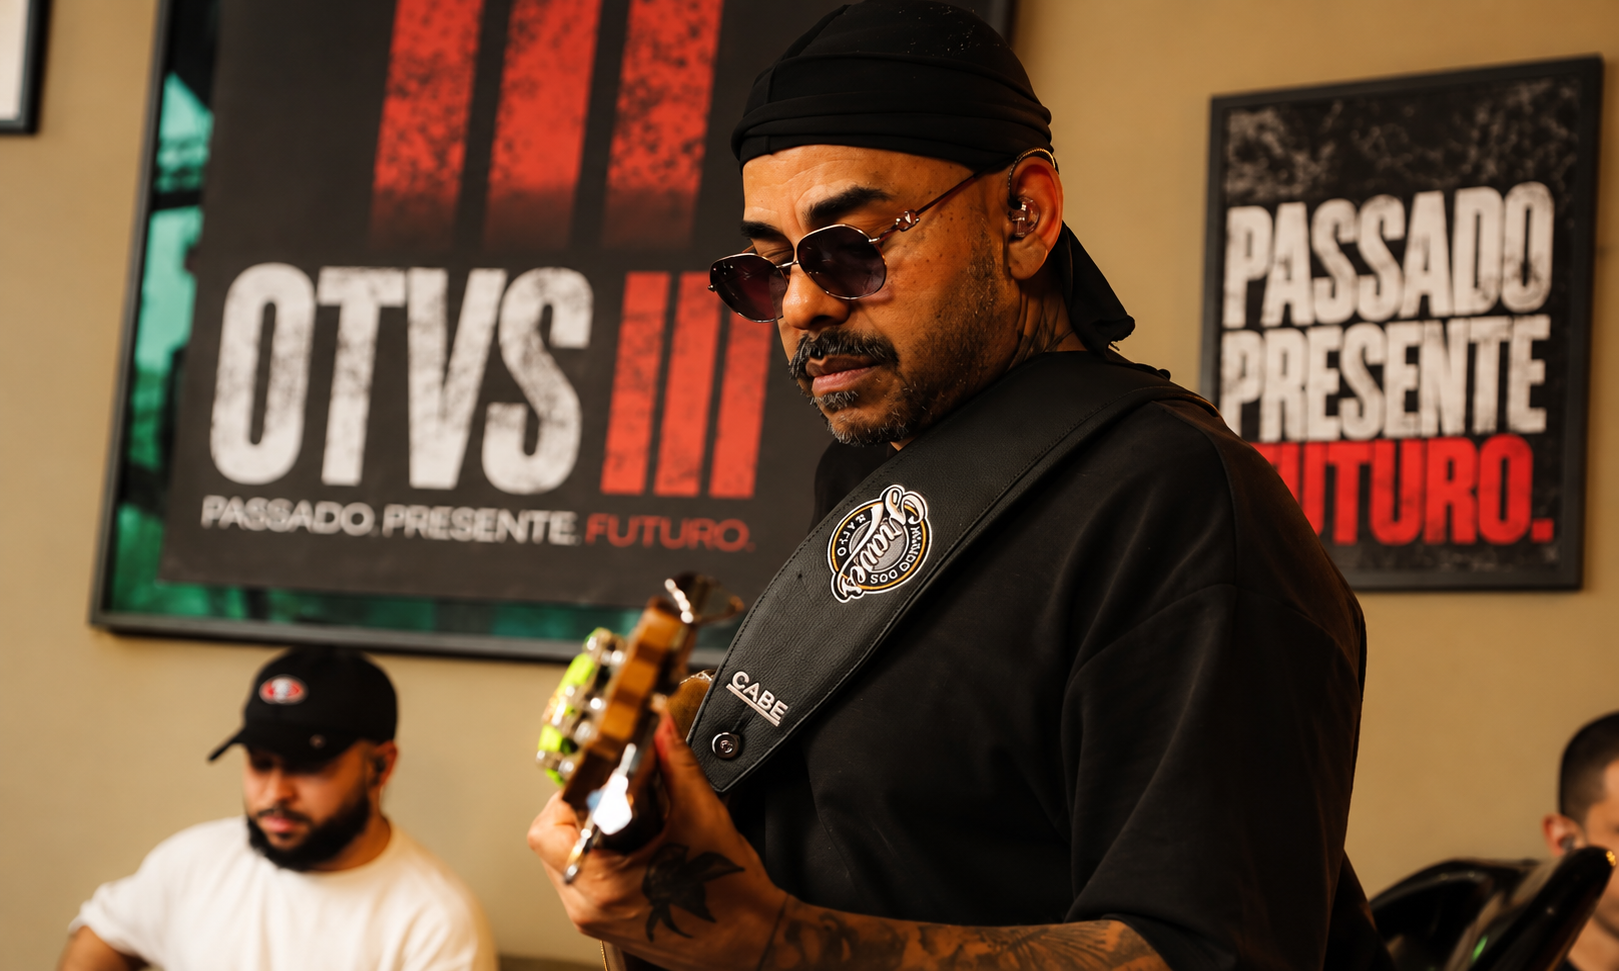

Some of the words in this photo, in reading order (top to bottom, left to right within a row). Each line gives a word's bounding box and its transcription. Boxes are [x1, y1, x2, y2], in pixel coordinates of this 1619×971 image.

[1224, 182, 1554, 328] PASSADO
[210, 262, 594, 494] OTVS
[1219, 313, 1552, 442] PRESENTE
[585, 513, 756, 553] FUTURO.
[732, 670, 789, 721] CABE
